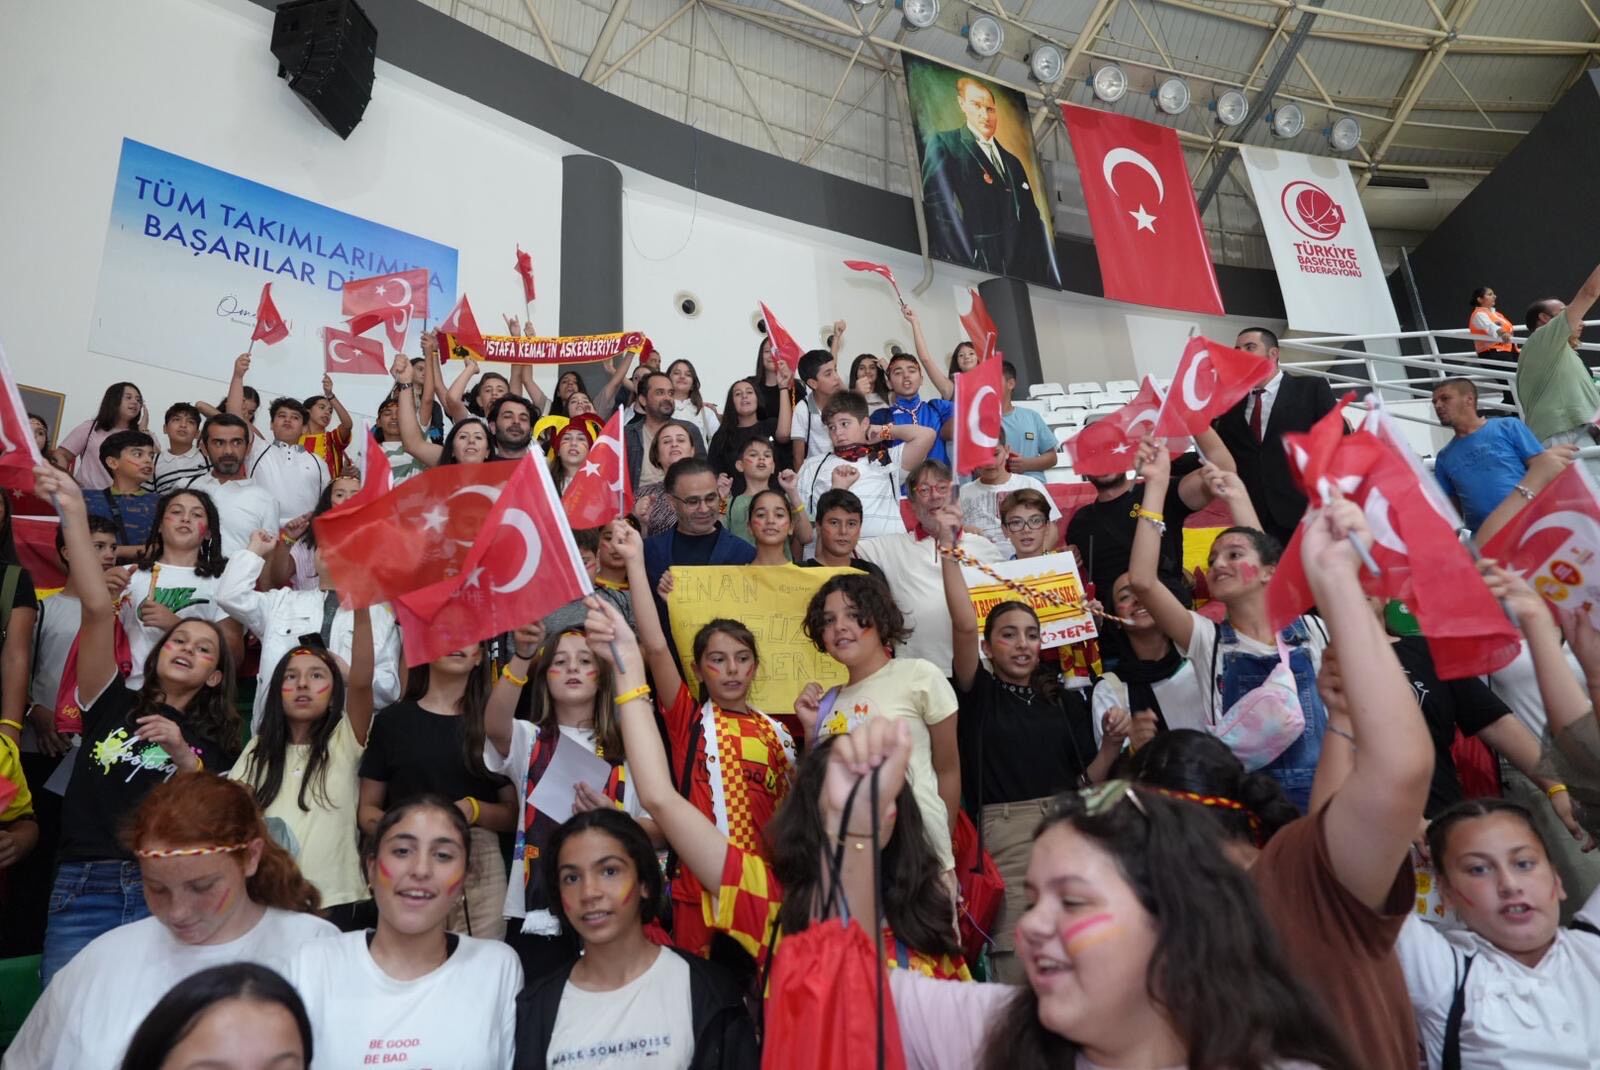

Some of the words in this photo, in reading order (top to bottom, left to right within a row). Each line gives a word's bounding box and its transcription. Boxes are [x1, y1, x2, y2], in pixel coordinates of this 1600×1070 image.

[135, 176, 207, 220] TÜM
[143, 213, 315, 285] BAŞARILAR
[1293, 240, 1357, 260] TÜRKİYE
[1297, 255, 1360, 270] BASKETBOL
[1300, 264, 1362, 278] FEDERASYONU
[369, 1039, 384, 1050] BE
[589, 1043, 623, 1058] SOME
[363, 1053, 380, 1065] BE
